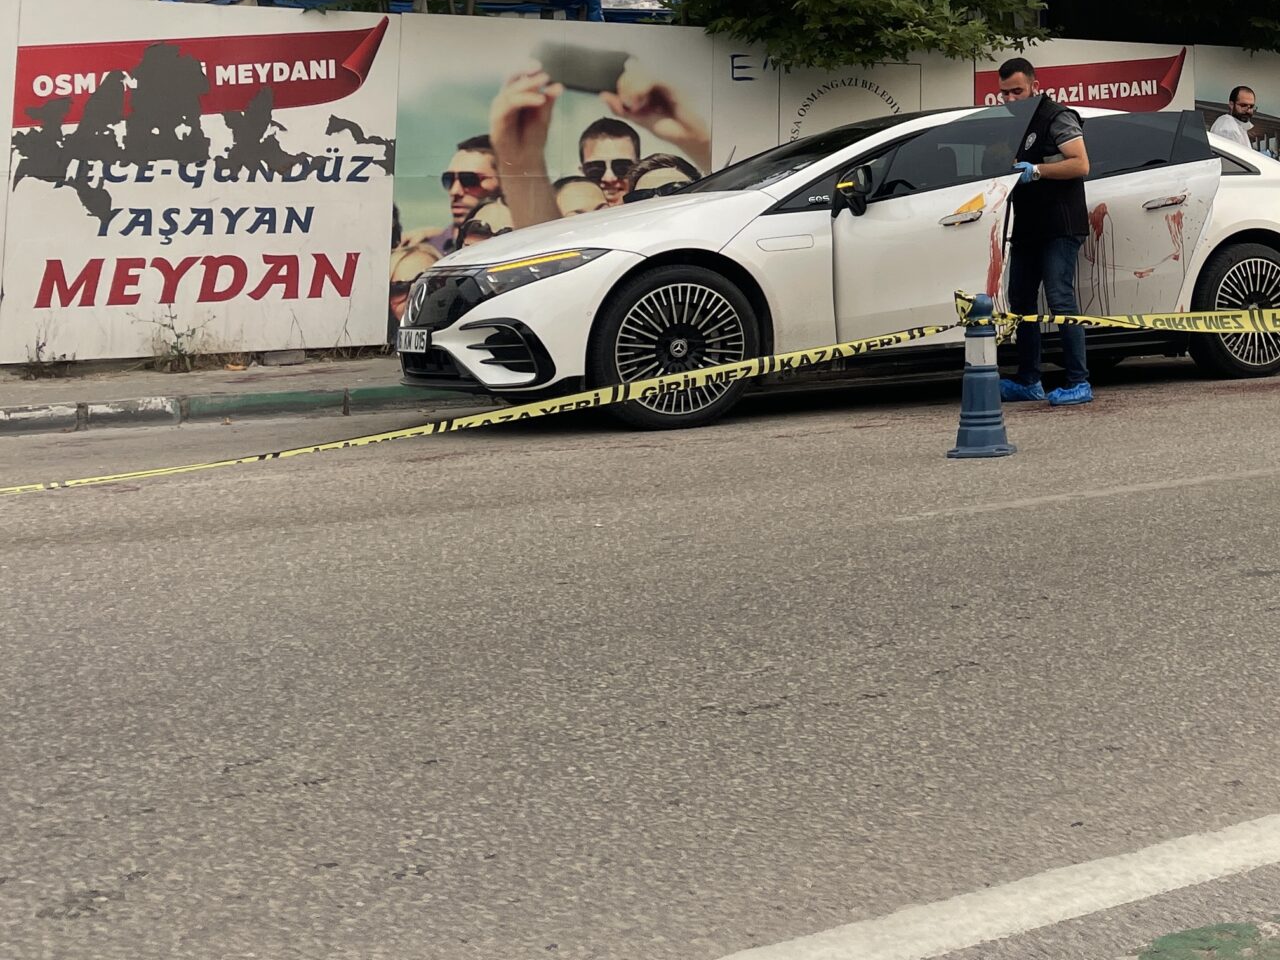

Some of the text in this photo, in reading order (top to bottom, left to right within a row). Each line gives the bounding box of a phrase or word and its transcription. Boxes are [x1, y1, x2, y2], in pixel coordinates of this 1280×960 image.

[215, 59, 336, 85] MEYDANI
[1088, 80, 1157, 101] MEYDANI
[97, 206, 315, 245] YAŞAYAN
[33, 252, 361, 308] MEYDAN
[780, 348, 842, 371] KAZA
